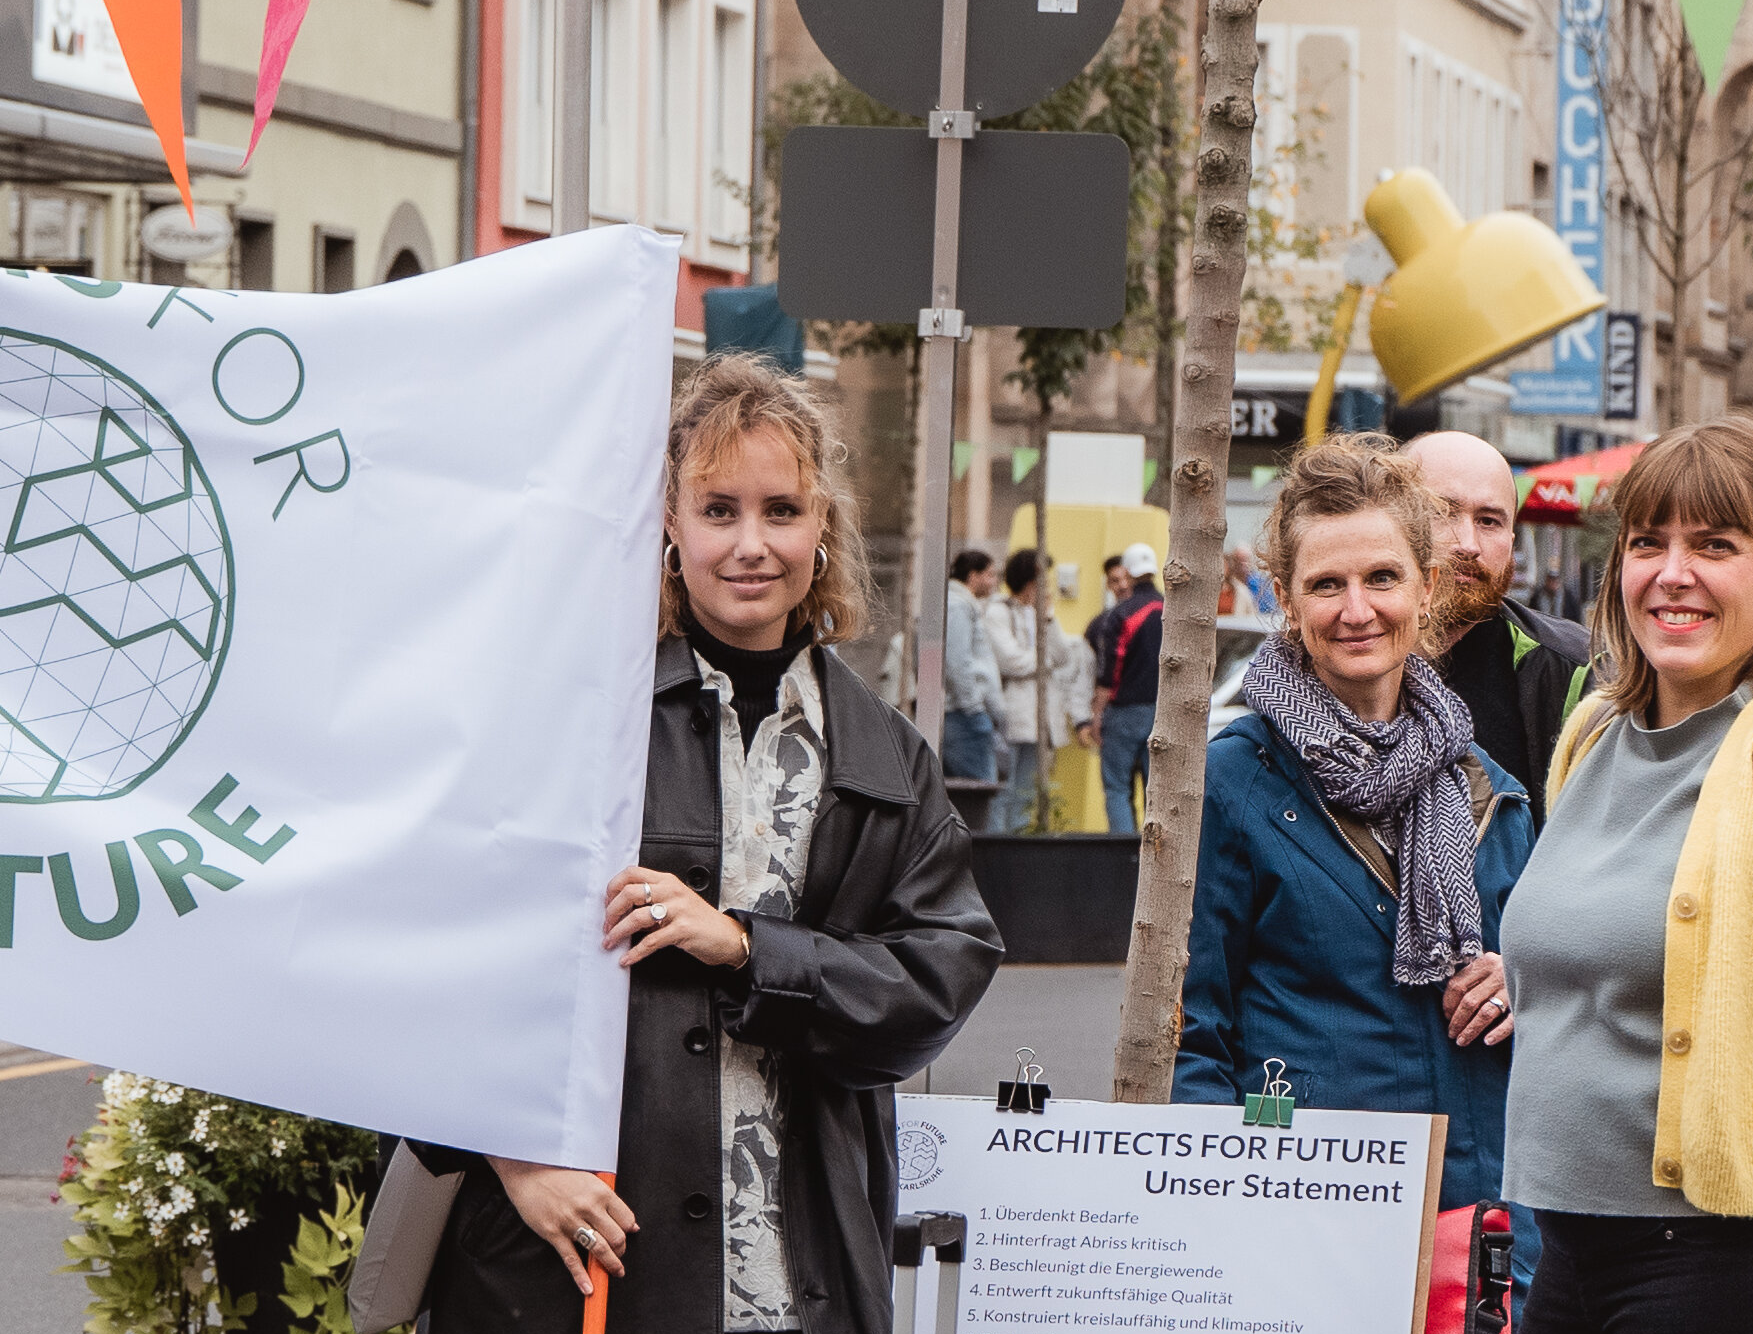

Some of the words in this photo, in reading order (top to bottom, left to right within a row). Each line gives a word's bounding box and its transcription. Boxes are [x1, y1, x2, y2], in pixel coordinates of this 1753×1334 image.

[1608, 320, 1636, 411] KIND
[985, 1127, 1193, 1158] ARCHITECTS
[1200, 1133, 1268, 1161] FOR
[1276, 1136, 1408, 1165] FUTURE
[1145, 1170, 1236, 1197] Unser
[1241, 1173, 1404, 1204] Statement
[979, 1207, 992, 1221] 1.
[995, 1205, 1077, 1223] Überdenkt
[1079, 1209, 1140, 1225] Bedarfe
[975, 1232, 989, 1246] 2.
[992, 1232, 1078, 1251] Hinterfragt
[1079, 1235, 1128, 1250] Abriss
[1131, 1236, 1187, 1252] kritisch
[972, 1257, 987, 1271] 3.
[989, 1257, 1087, 1277] Beschleunigt
[1088, 1260, 1112, 1275] die
[1115, 1262, 1224, 1280] Energiewende
[969, 1283, 983, 1297] 4.
[986, 1283, 1053, 1299] Entwerft
[1055, 1285, 1168, 1305] zukunftsfähige
[1171, 1289, 1233, 1306] Qualität
[966, 1308, 980, 1322] 5.
[983, 1308, 1072, 1326] Konstruiert
[1073, 1311, 1177, 1332] kreislauffähig
[1179, 1316, 1209, 1330] und
[1211, 1316, 1304, 1334] klimapositiv
